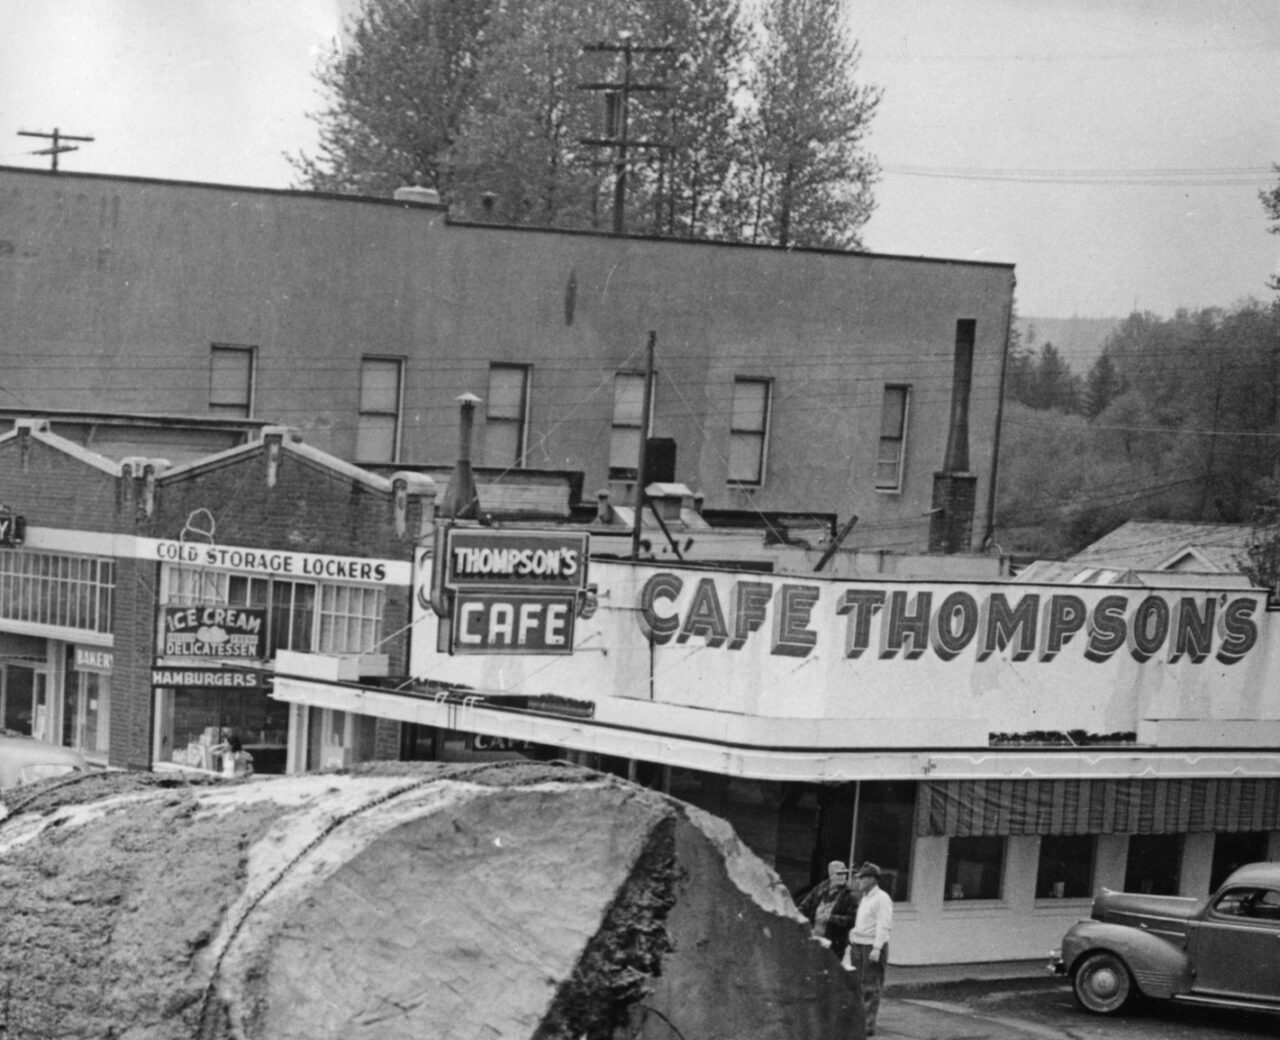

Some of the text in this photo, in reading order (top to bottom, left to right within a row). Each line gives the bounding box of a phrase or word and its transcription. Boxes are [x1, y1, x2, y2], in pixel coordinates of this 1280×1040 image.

[156, 542, 387, 582] COLD STORAGE LOCKERS
[454, 546, 578, 576] THOMPSON'S
[166, 607, 261, 634] ICE CREAM
[459, 601, 568, 645] CAFE
[635, 572, 1259, 666] CAFE THOMPSON'S
[166, 641, 257, 656] DELICATESSEN
[152, 670, 257, 687] HAMBURGERS
